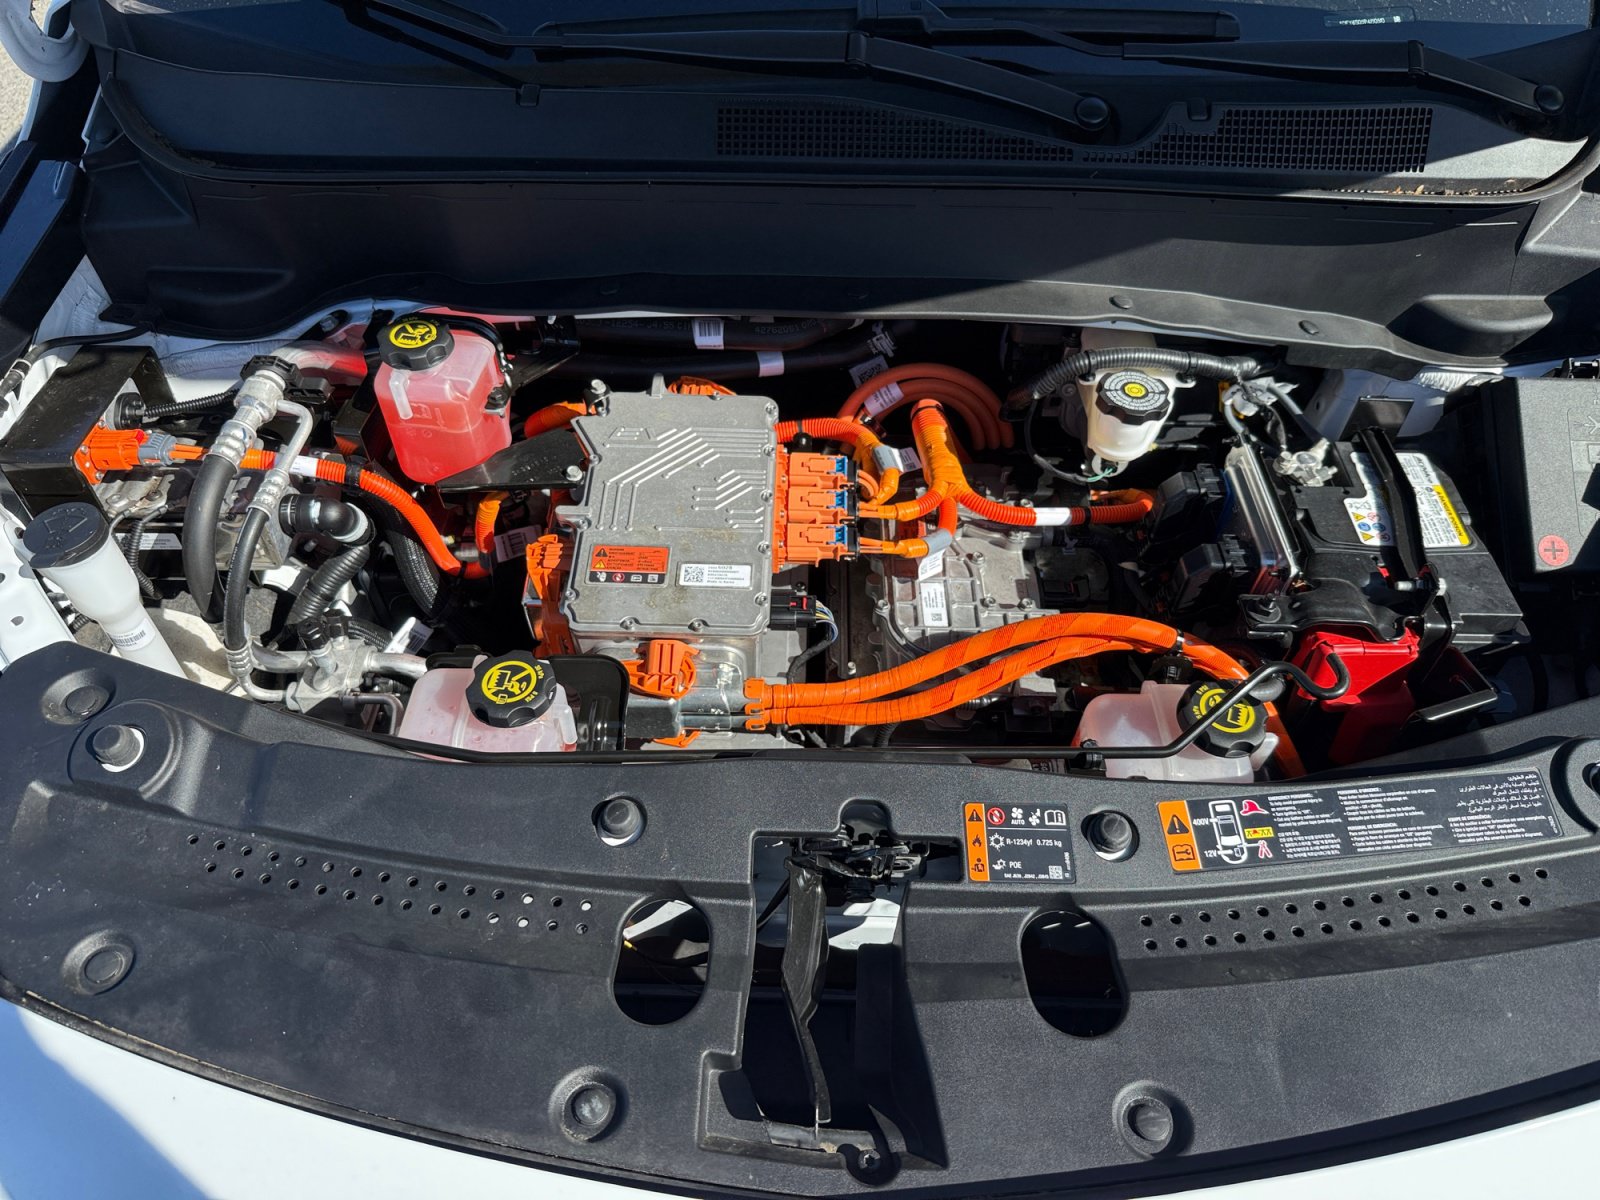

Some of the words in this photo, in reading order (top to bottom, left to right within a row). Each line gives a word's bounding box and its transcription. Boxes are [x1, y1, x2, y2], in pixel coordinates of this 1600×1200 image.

[1193, 818, 1208, 826] 400V
[1006, 839, 1033, 847] R-1234yf
[1054, 840, 1062, 848] kg
